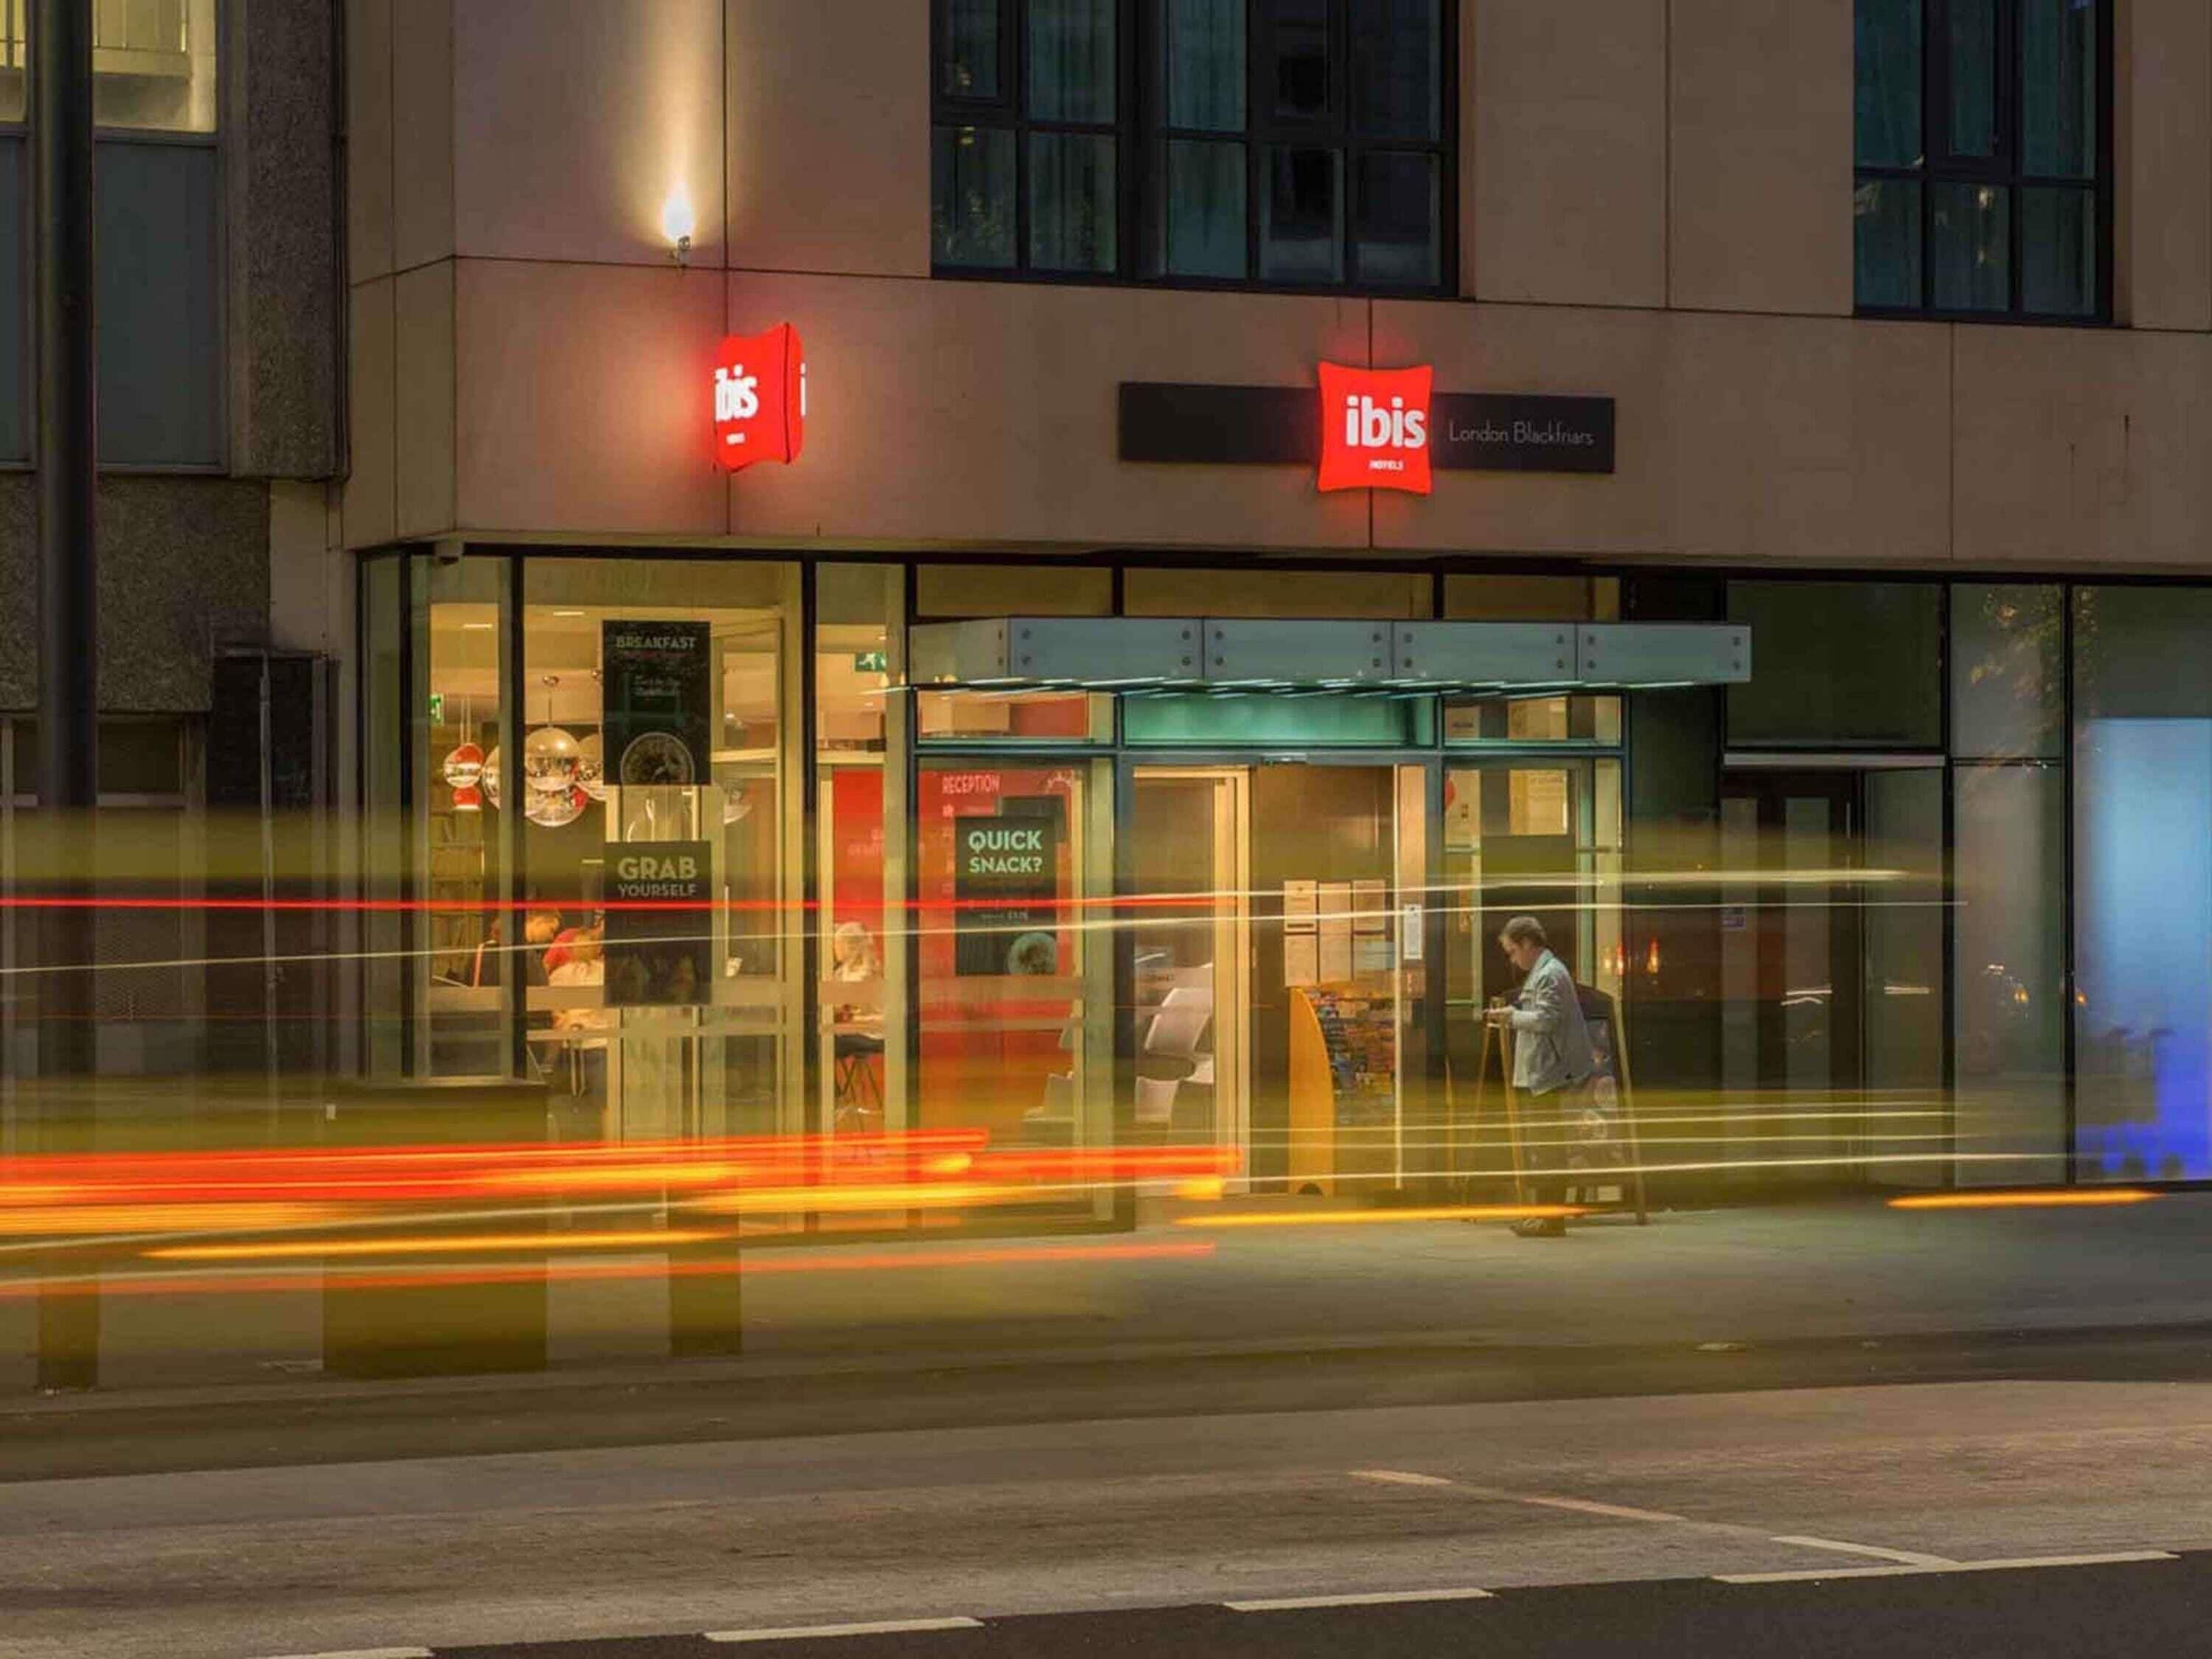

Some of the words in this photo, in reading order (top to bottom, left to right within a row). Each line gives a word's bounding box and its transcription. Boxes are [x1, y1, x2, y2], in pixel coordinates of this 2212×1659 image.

[1346, 395, 1426, 448] ibis
[1449, 420, 1508, 442] London
[1514, 420, 1595, 445] Blackfriars
[616, 636, 696, 650] BREAKFAST
[942, 775, 1000, 794] RECEPTION
[968, 830, 1043, 852] QUICK
[617, 857, 696, 880] GRAB
[969, 857, 1043, 873] SNACK?
[617, 883, 697, 897] YOURSELF
